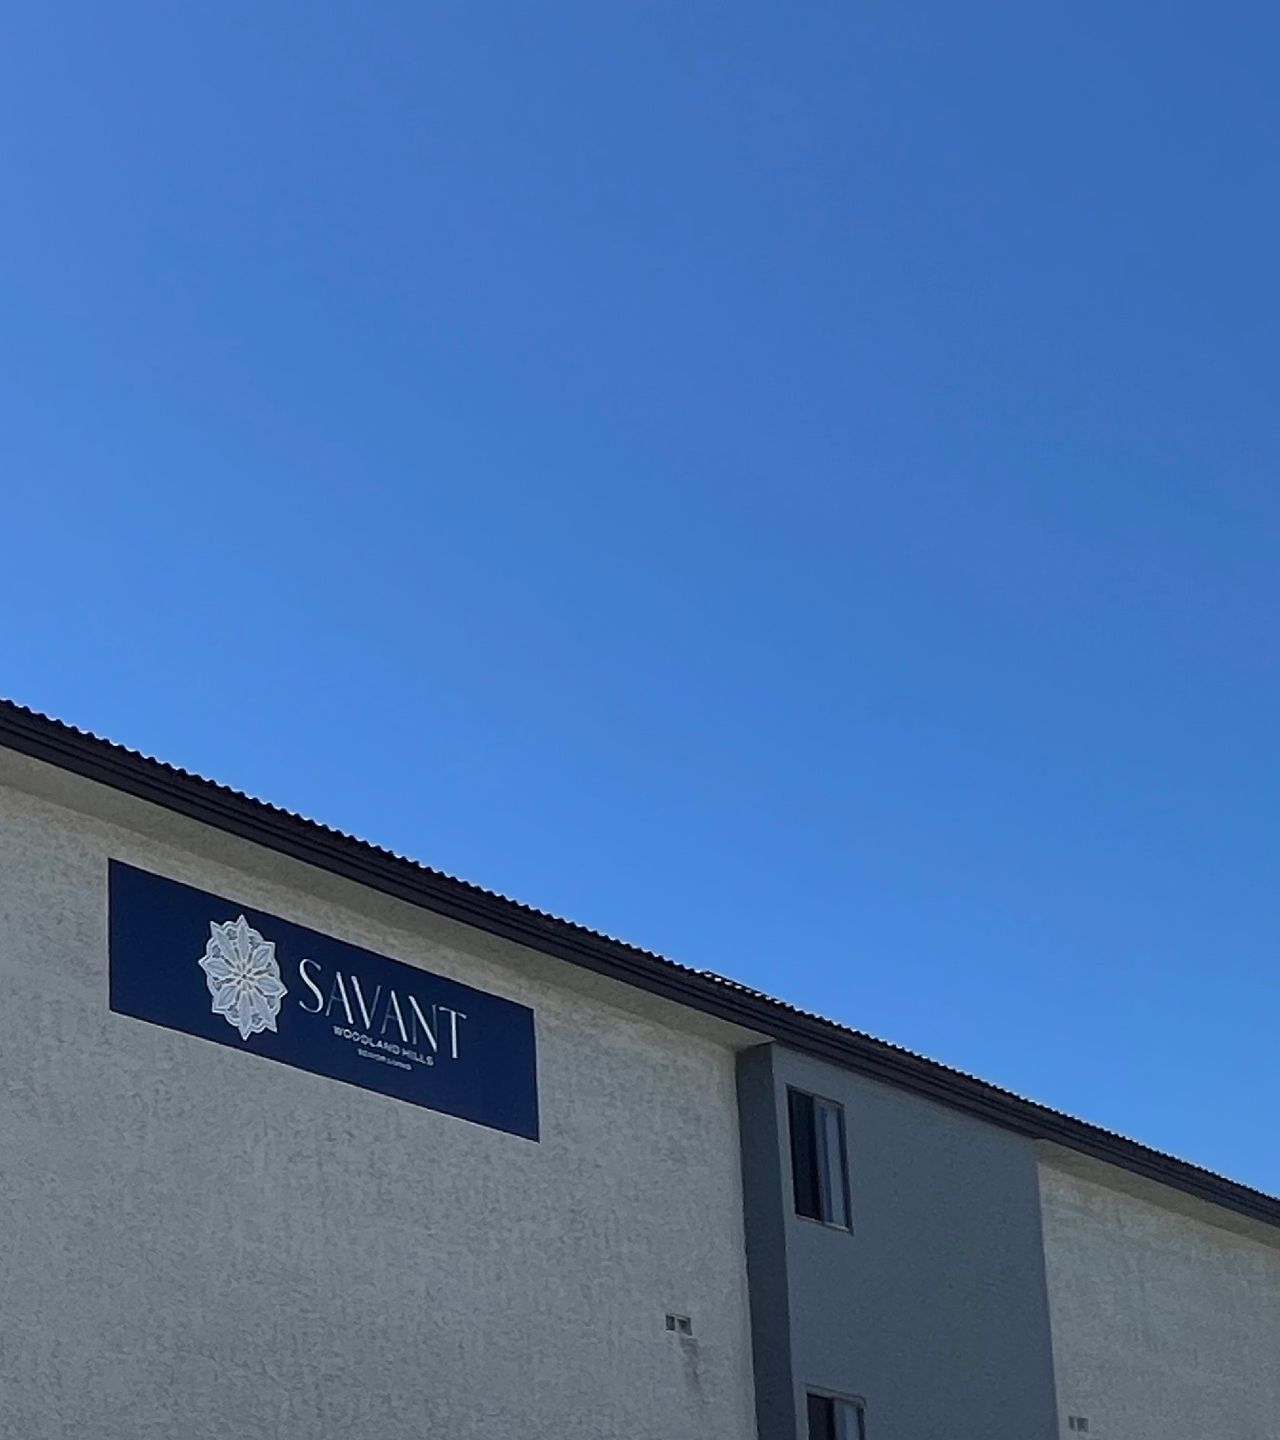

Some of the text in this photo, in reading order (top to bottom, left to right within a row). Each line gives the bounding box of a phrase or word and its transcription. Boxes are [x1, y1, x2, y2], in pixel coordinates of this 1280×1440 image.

[298, 958, 468, 1059] SAVANT
[332, 1024, 435, 1067] WOODLAND HILLS
